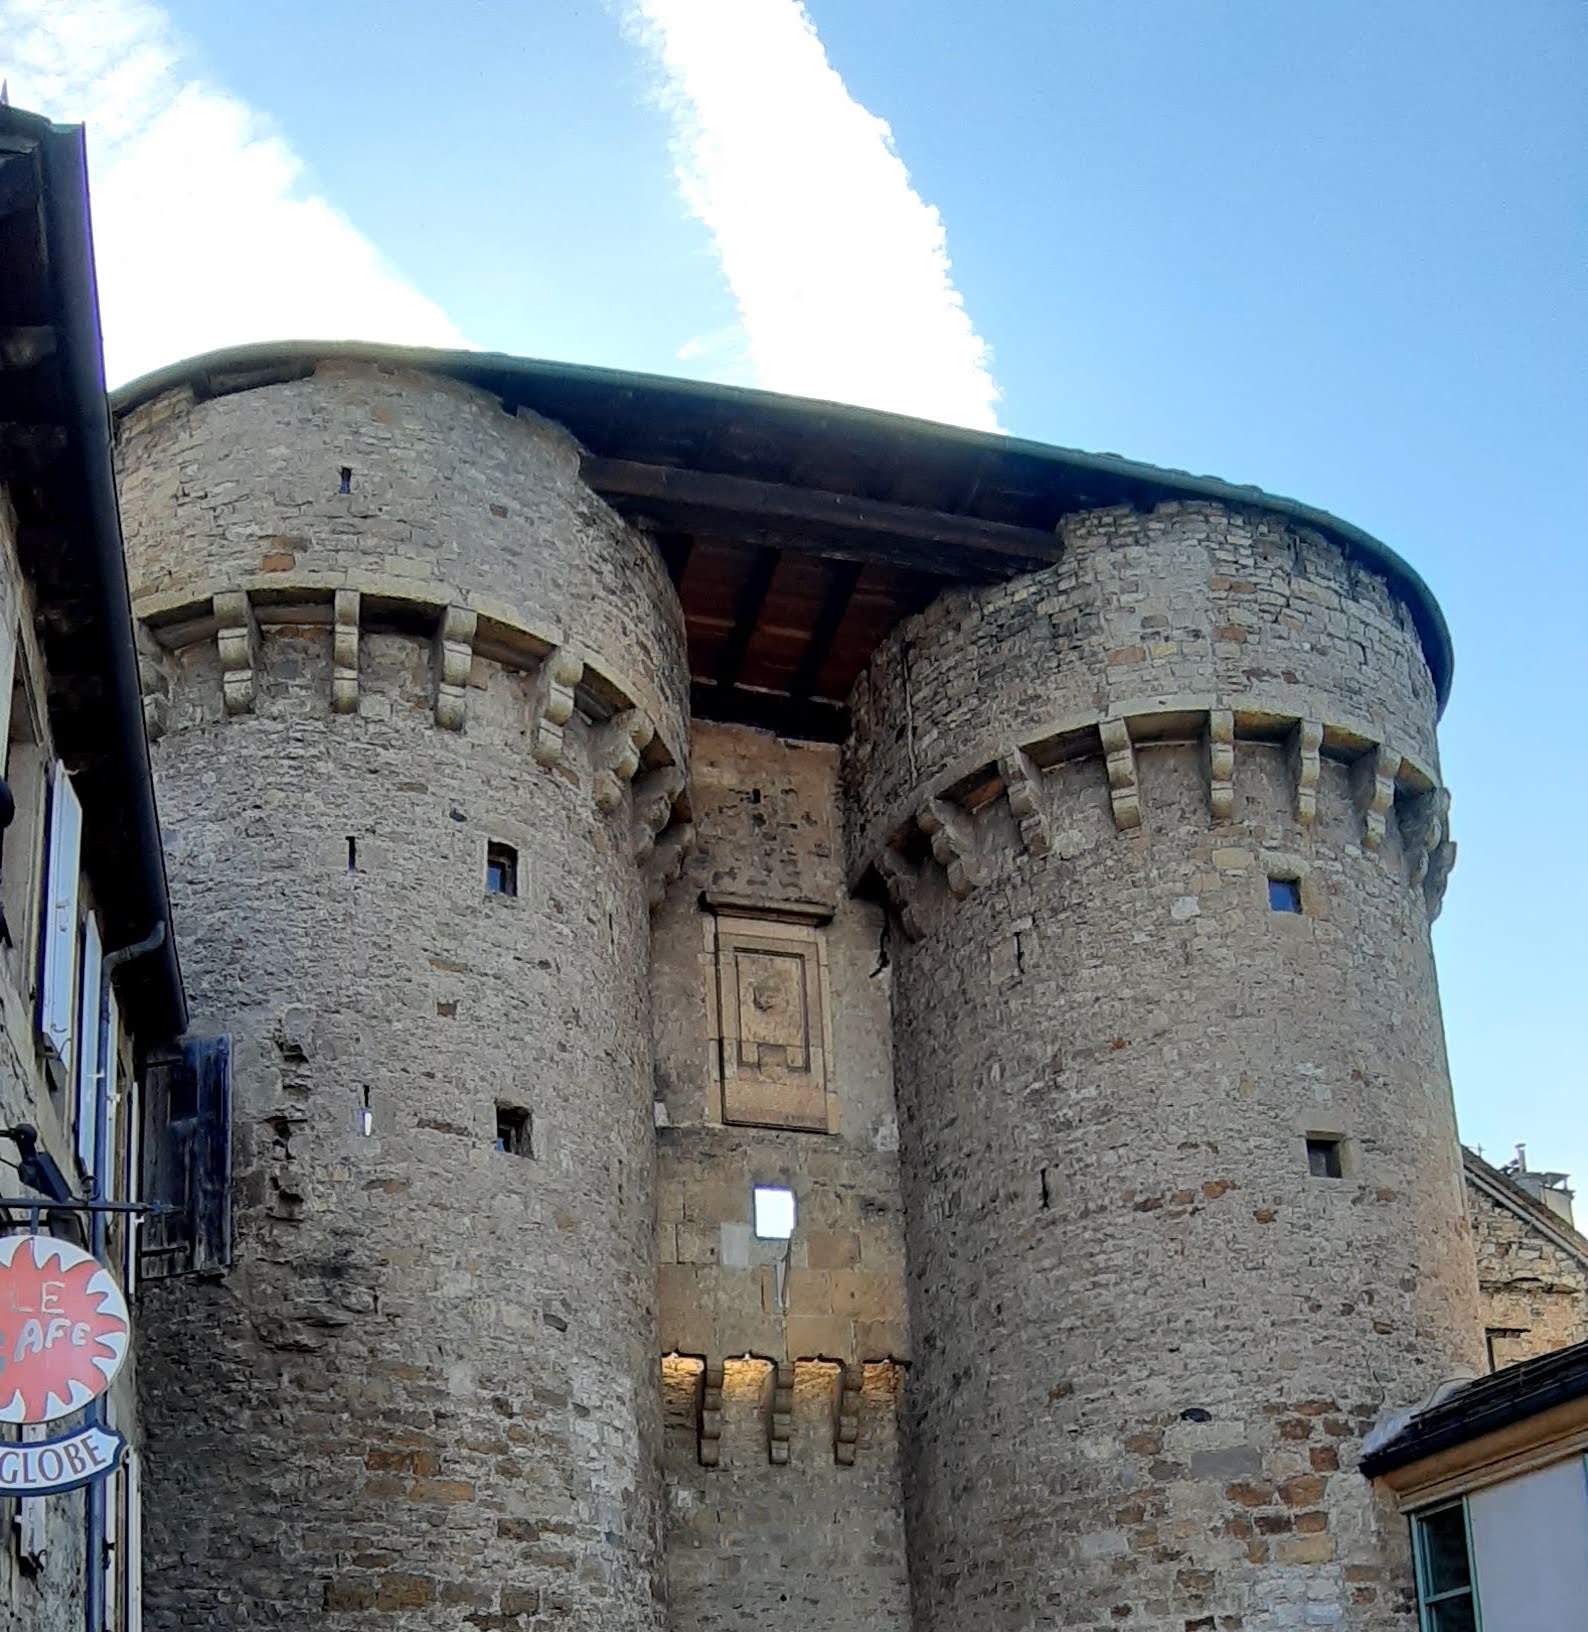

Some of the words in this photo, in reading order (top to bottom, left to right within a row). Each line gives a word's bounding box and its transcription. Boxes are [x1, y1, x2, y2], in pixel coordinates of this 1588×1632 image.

[9, 1281, 65, 1314] LE
[0, 1318, 91, 1376] AFE
[0, 1434, 106, 1483] GLOBE
